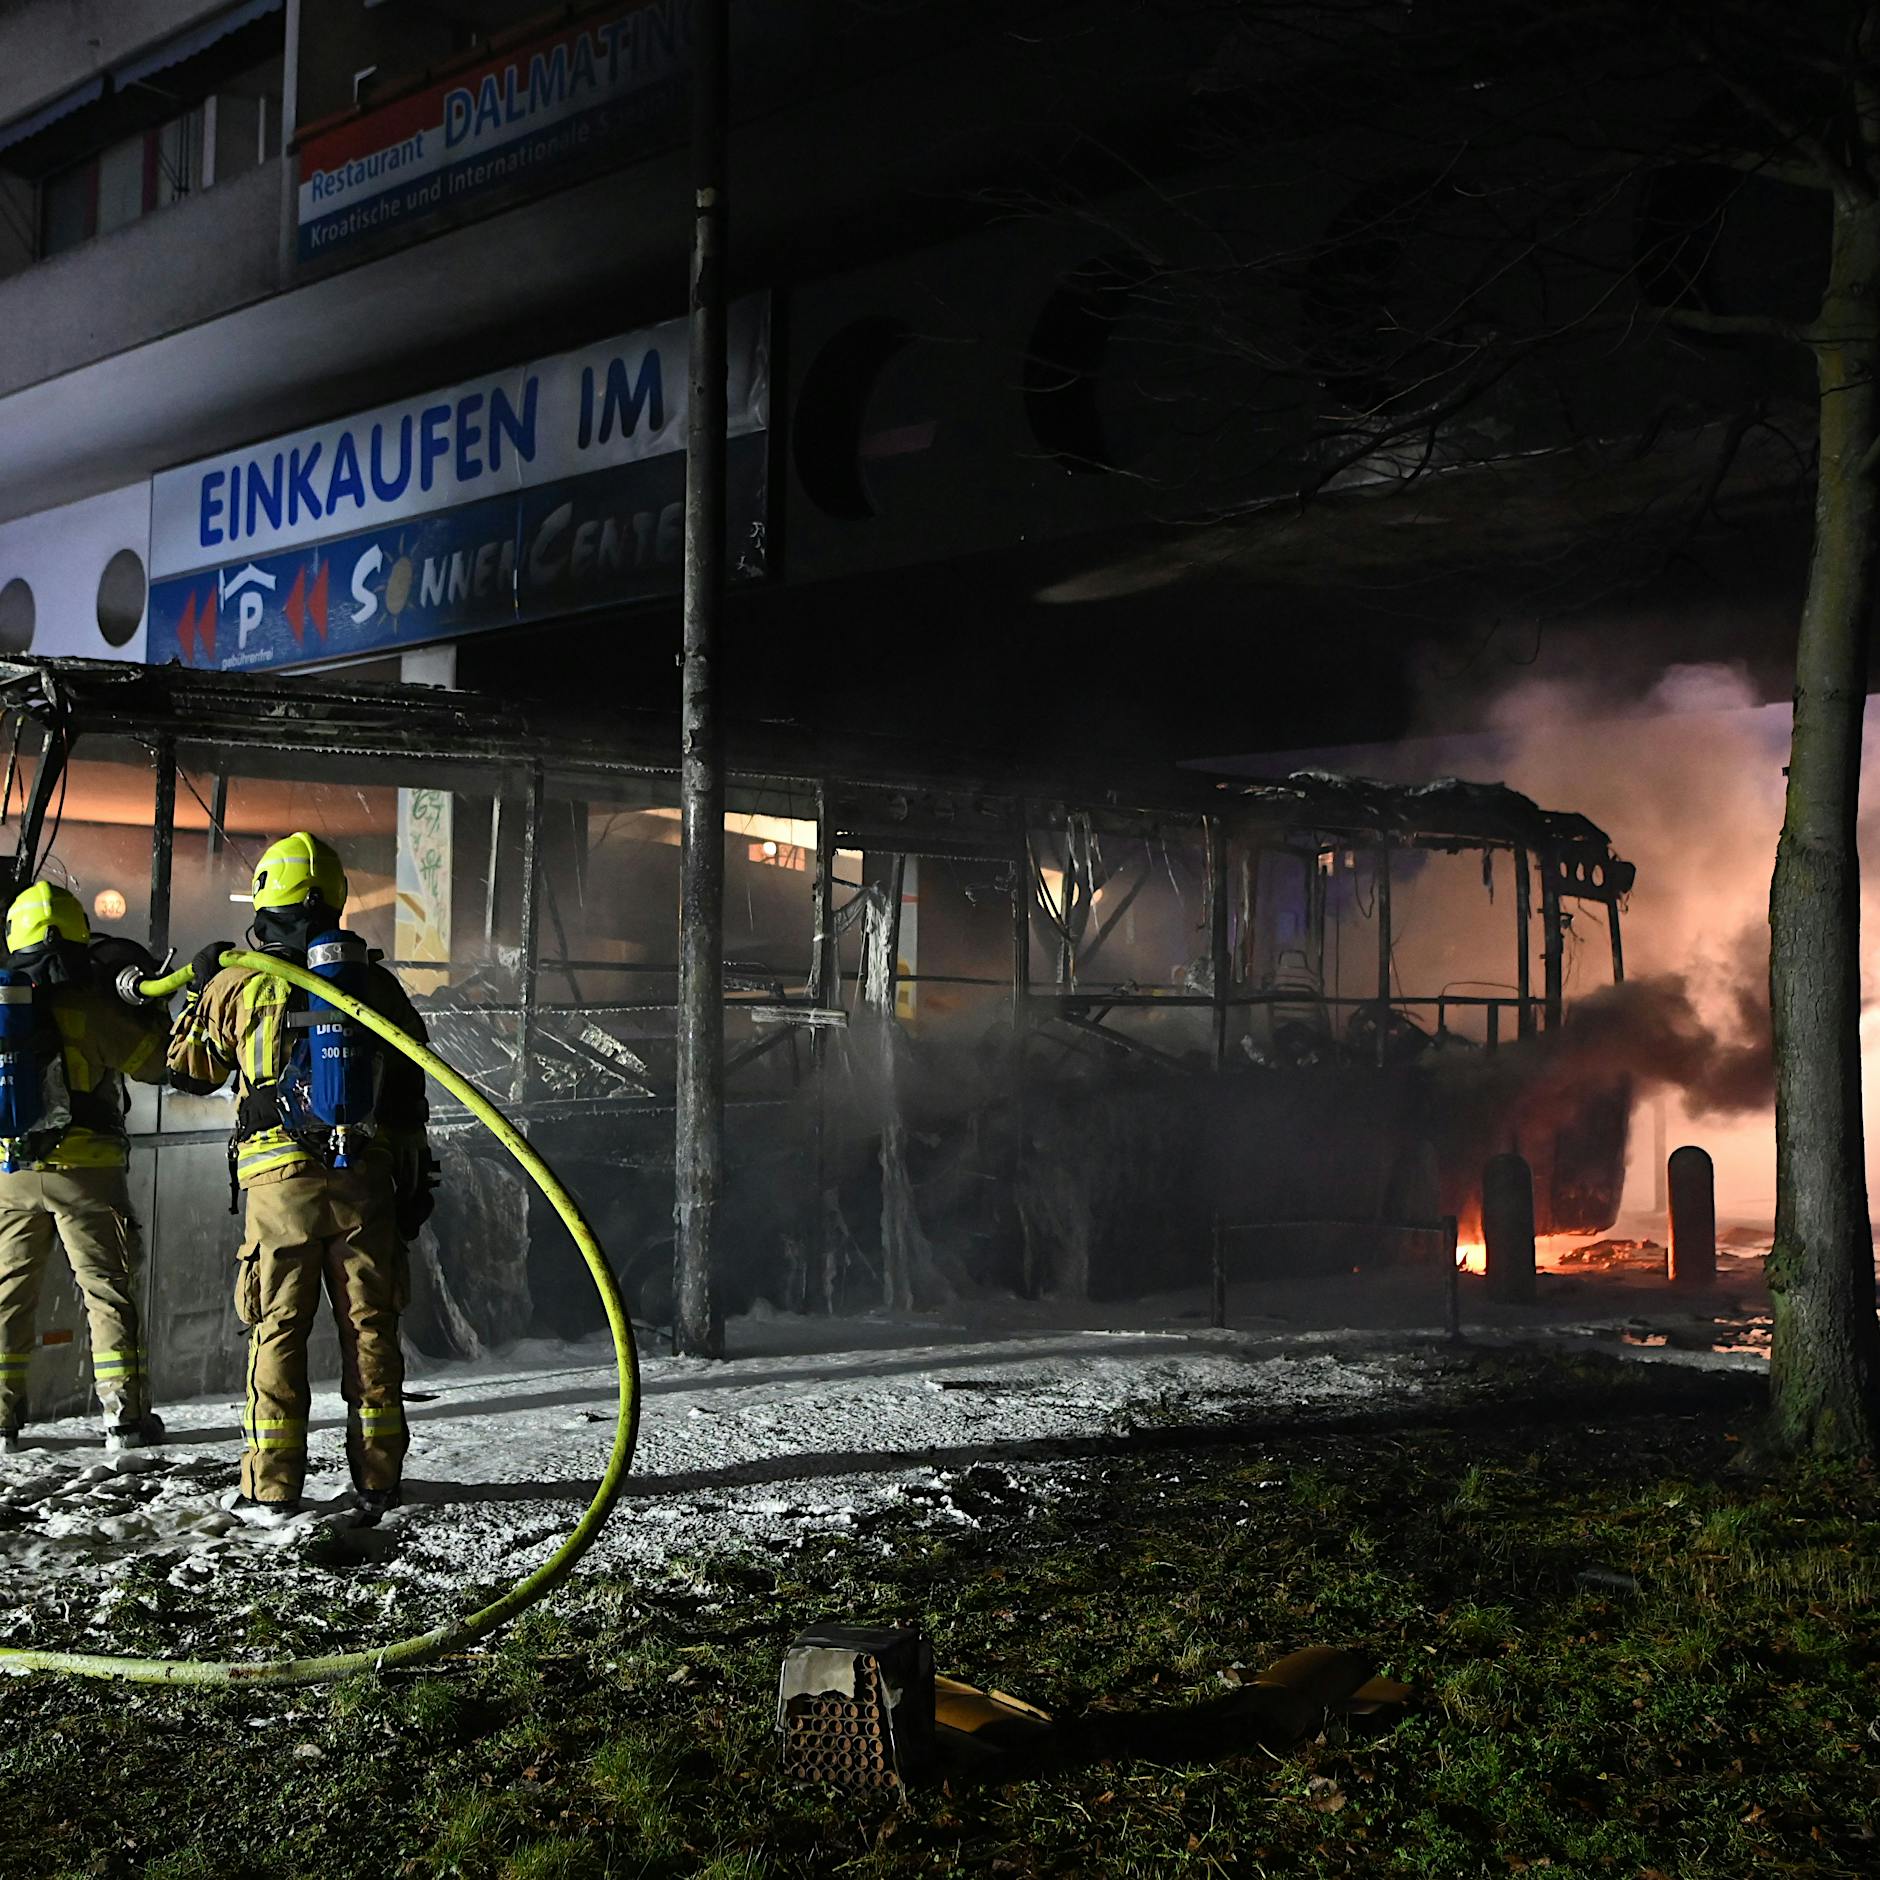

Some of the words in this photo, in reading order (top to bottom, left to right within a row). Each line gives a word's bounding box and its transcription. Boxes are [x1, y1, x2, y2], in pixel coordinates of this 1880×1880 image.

[311, 196, 401, 249] Kroatische
[406, 175, 442, 210] und
[447, 120, 591, 195] Internationale
[312, 132, 424, 203] Restaurant
[200, 375, 539, 548] EINKAUFEN
[578, 348, 665, 450] IM
[237, 590, 264, 650] P
[321, 1046, 340, 1059] 300
